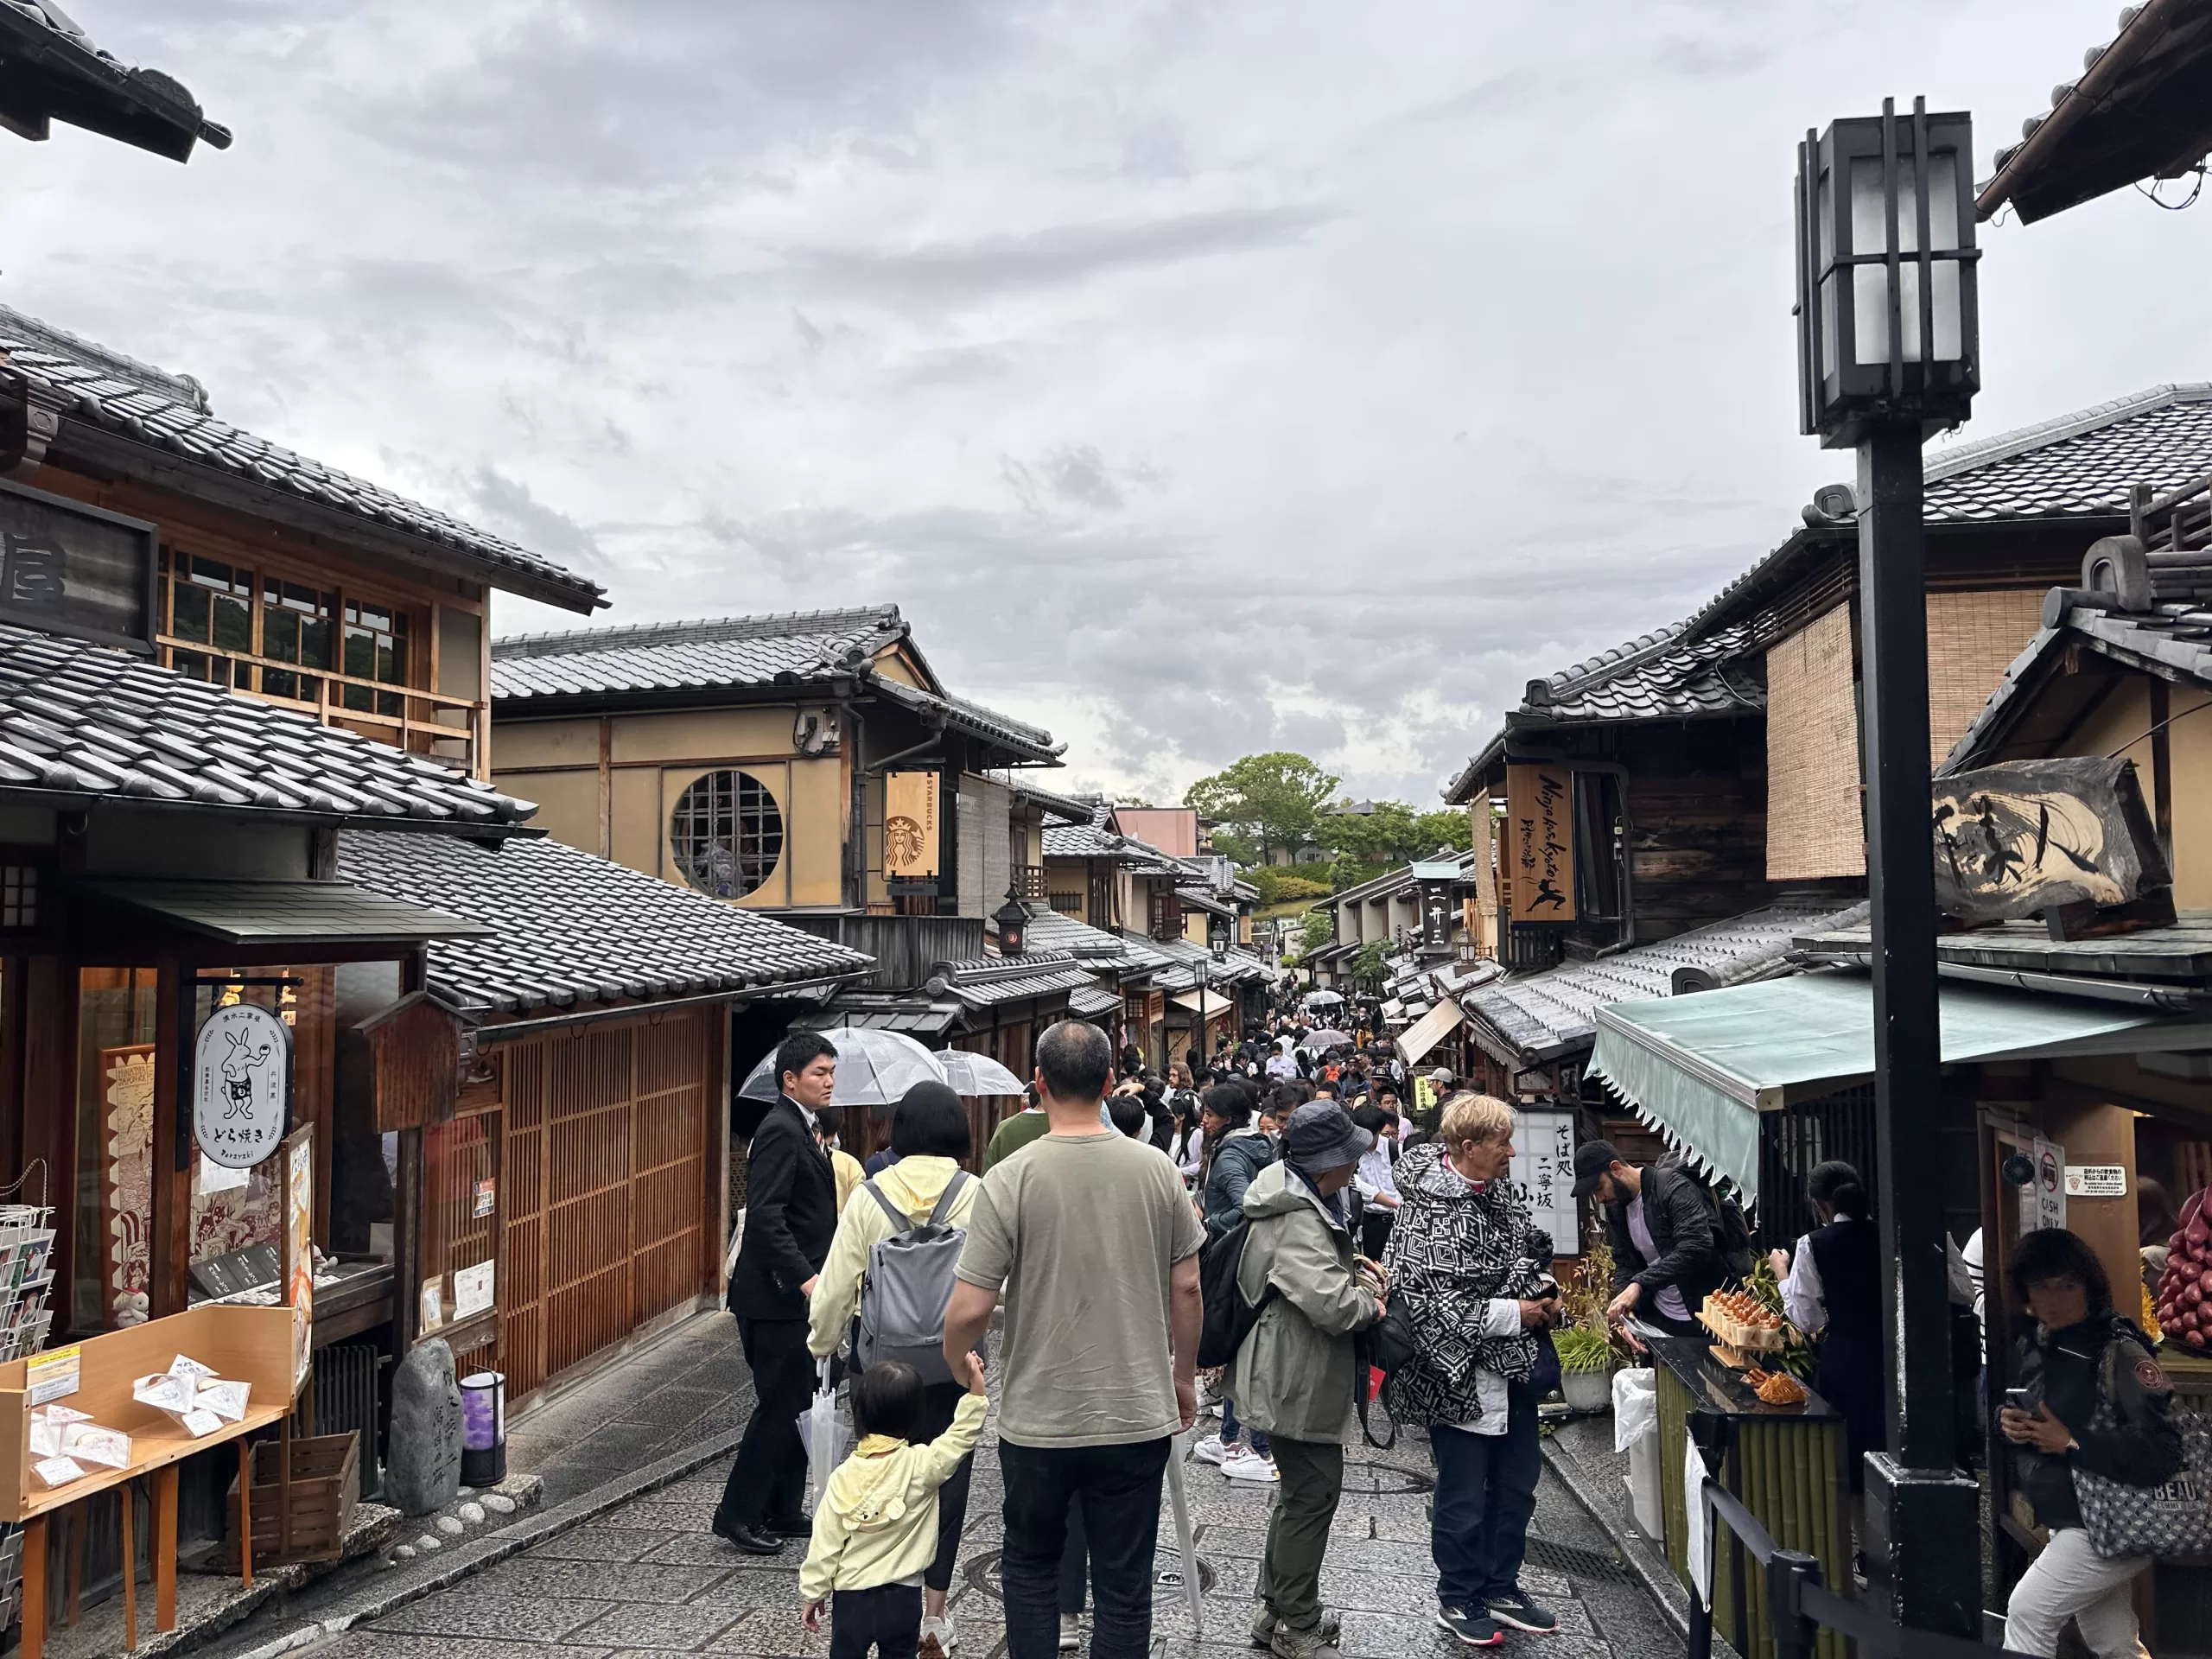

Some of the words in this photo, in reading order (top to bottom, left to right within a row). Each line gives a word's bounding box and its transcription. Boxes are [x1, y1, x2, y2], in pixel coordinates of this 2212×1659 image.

[1535, 774, 1564, 817] Ninja
[1538, 842, 1567, 878] Kyoto
[214, 1128, 263, 1143] どら焼き
[1556, 1124, 1573, 1177] そば処
[1537, 1157, 1554, 1209] 二寧坂
[2042, 1198, 2059, 1215] CASH
[2043, 1215, 2059, 1228] ONLY
